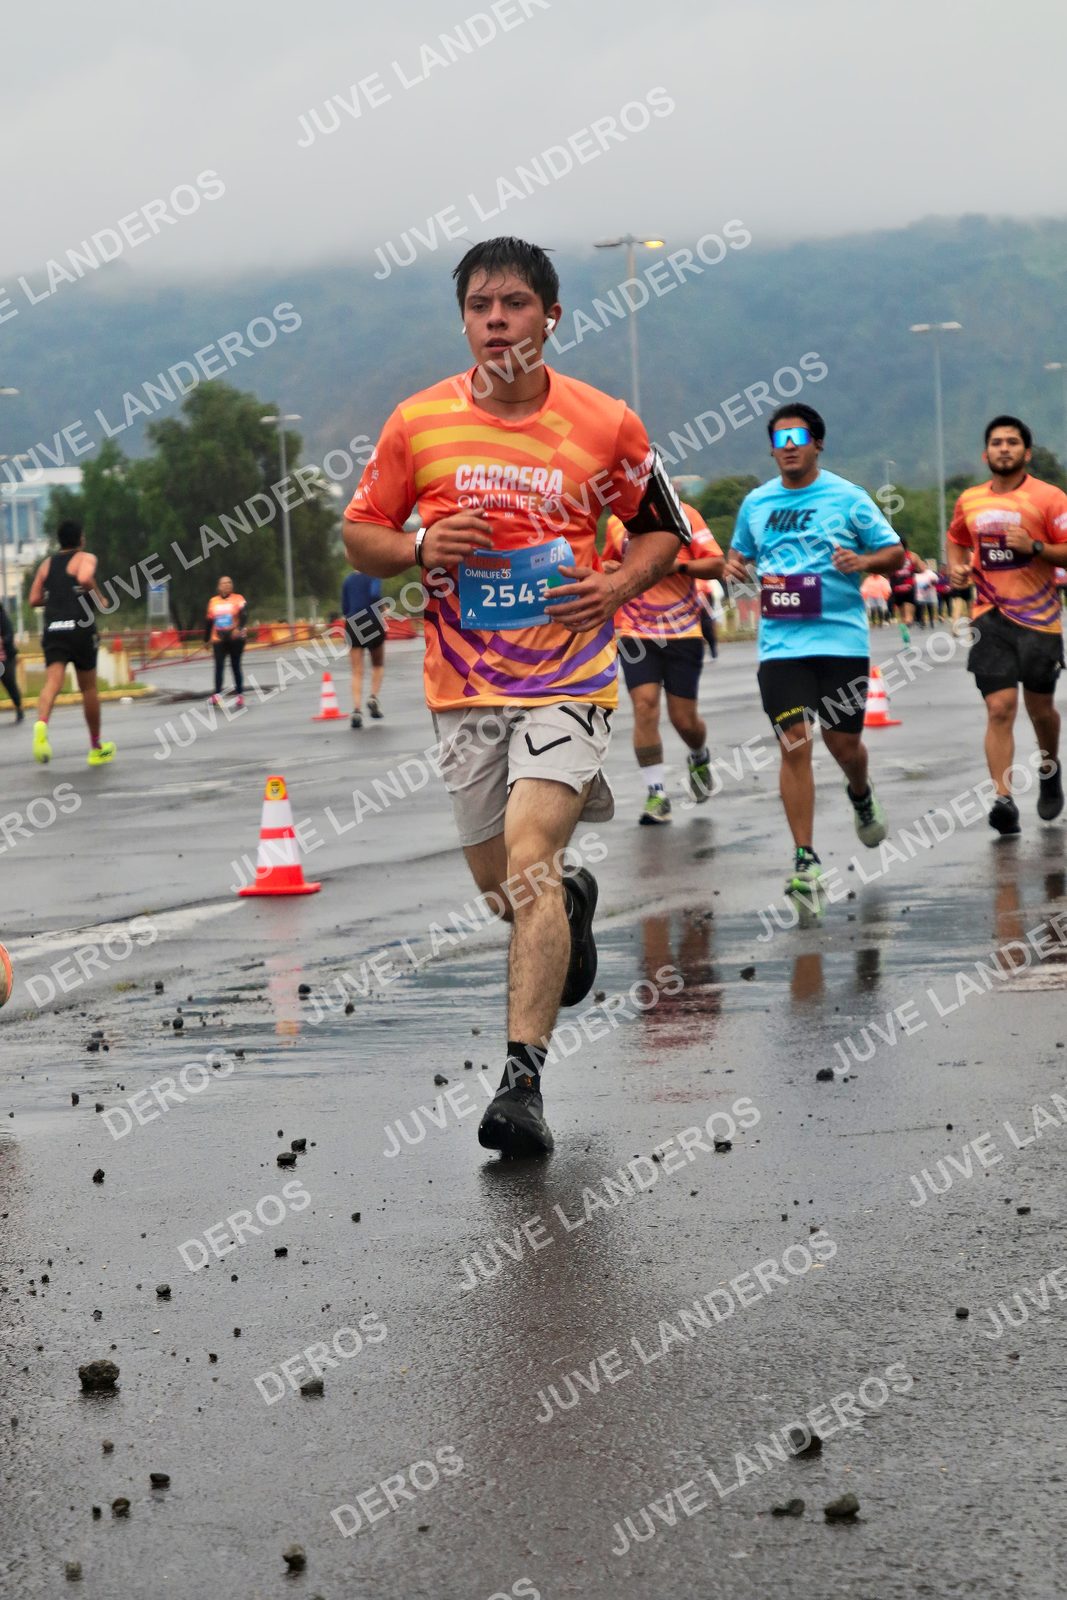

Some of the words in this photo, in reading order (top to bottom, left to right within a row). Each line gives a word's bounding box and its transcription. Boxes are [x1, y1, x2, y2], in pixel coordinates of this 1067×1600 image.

[455, 464, 563, 494] CARRERA
[764, 509, 818, 533] NIKE
[988, 549, 1014, 561] 690
[771, 592, 800, 606] 666
